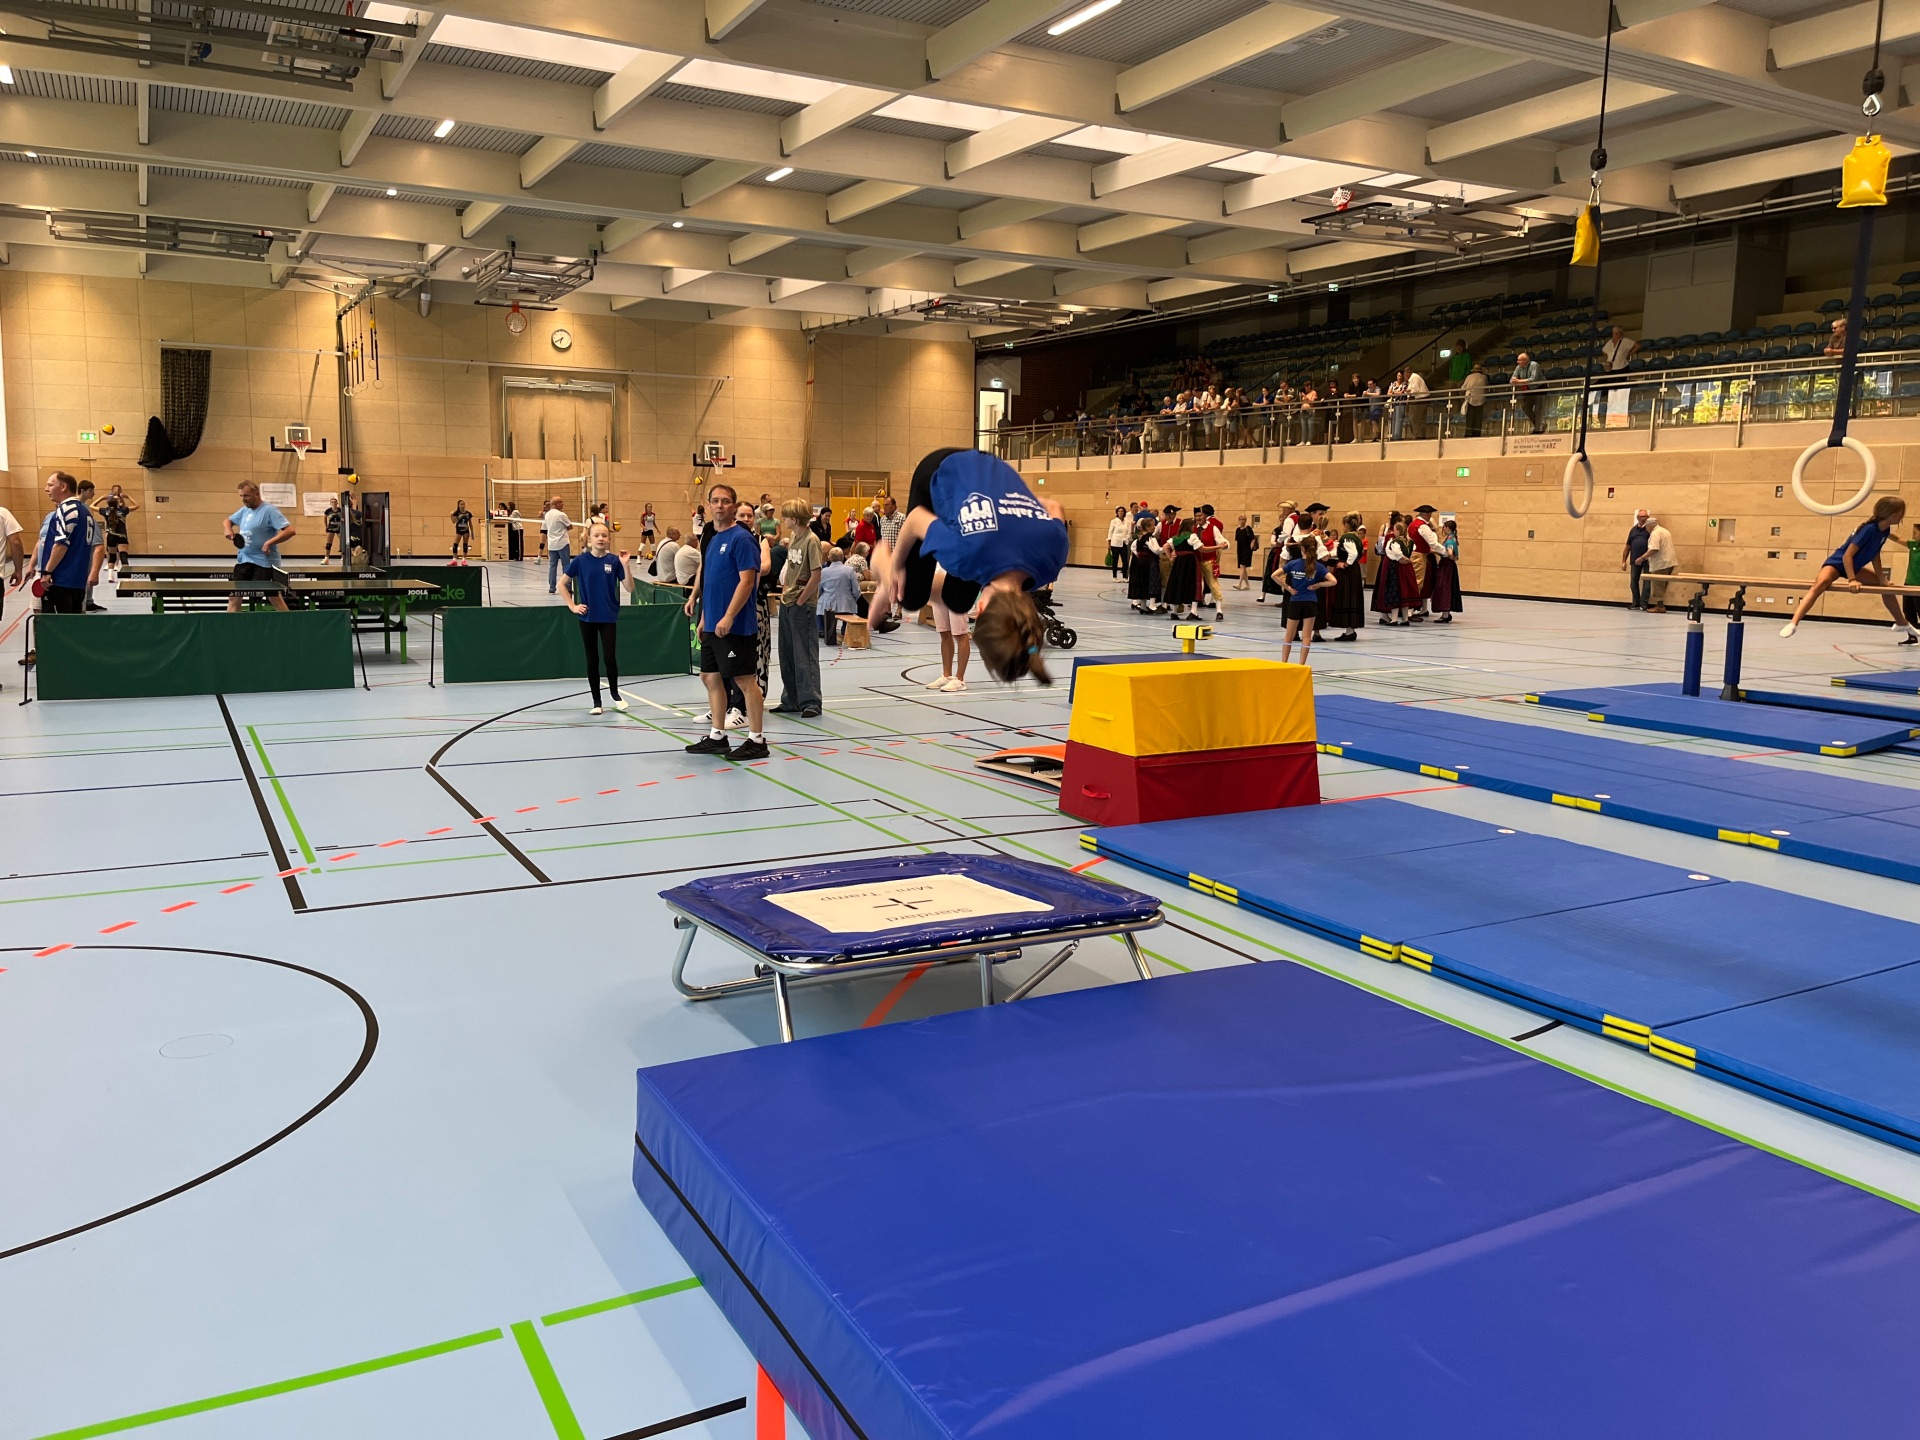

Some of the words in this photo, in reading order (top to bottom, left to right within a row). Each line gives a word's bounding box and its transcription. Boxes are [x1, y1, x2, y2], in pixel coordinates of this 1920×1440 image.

[998, 506, 1033, 518] Jahre
[86, 515, 94, 544] 6
[896, 885, 933, 894] Mini
[821, 891, 881, 902] Tramp
[885, 908, 972, 922] Standard
